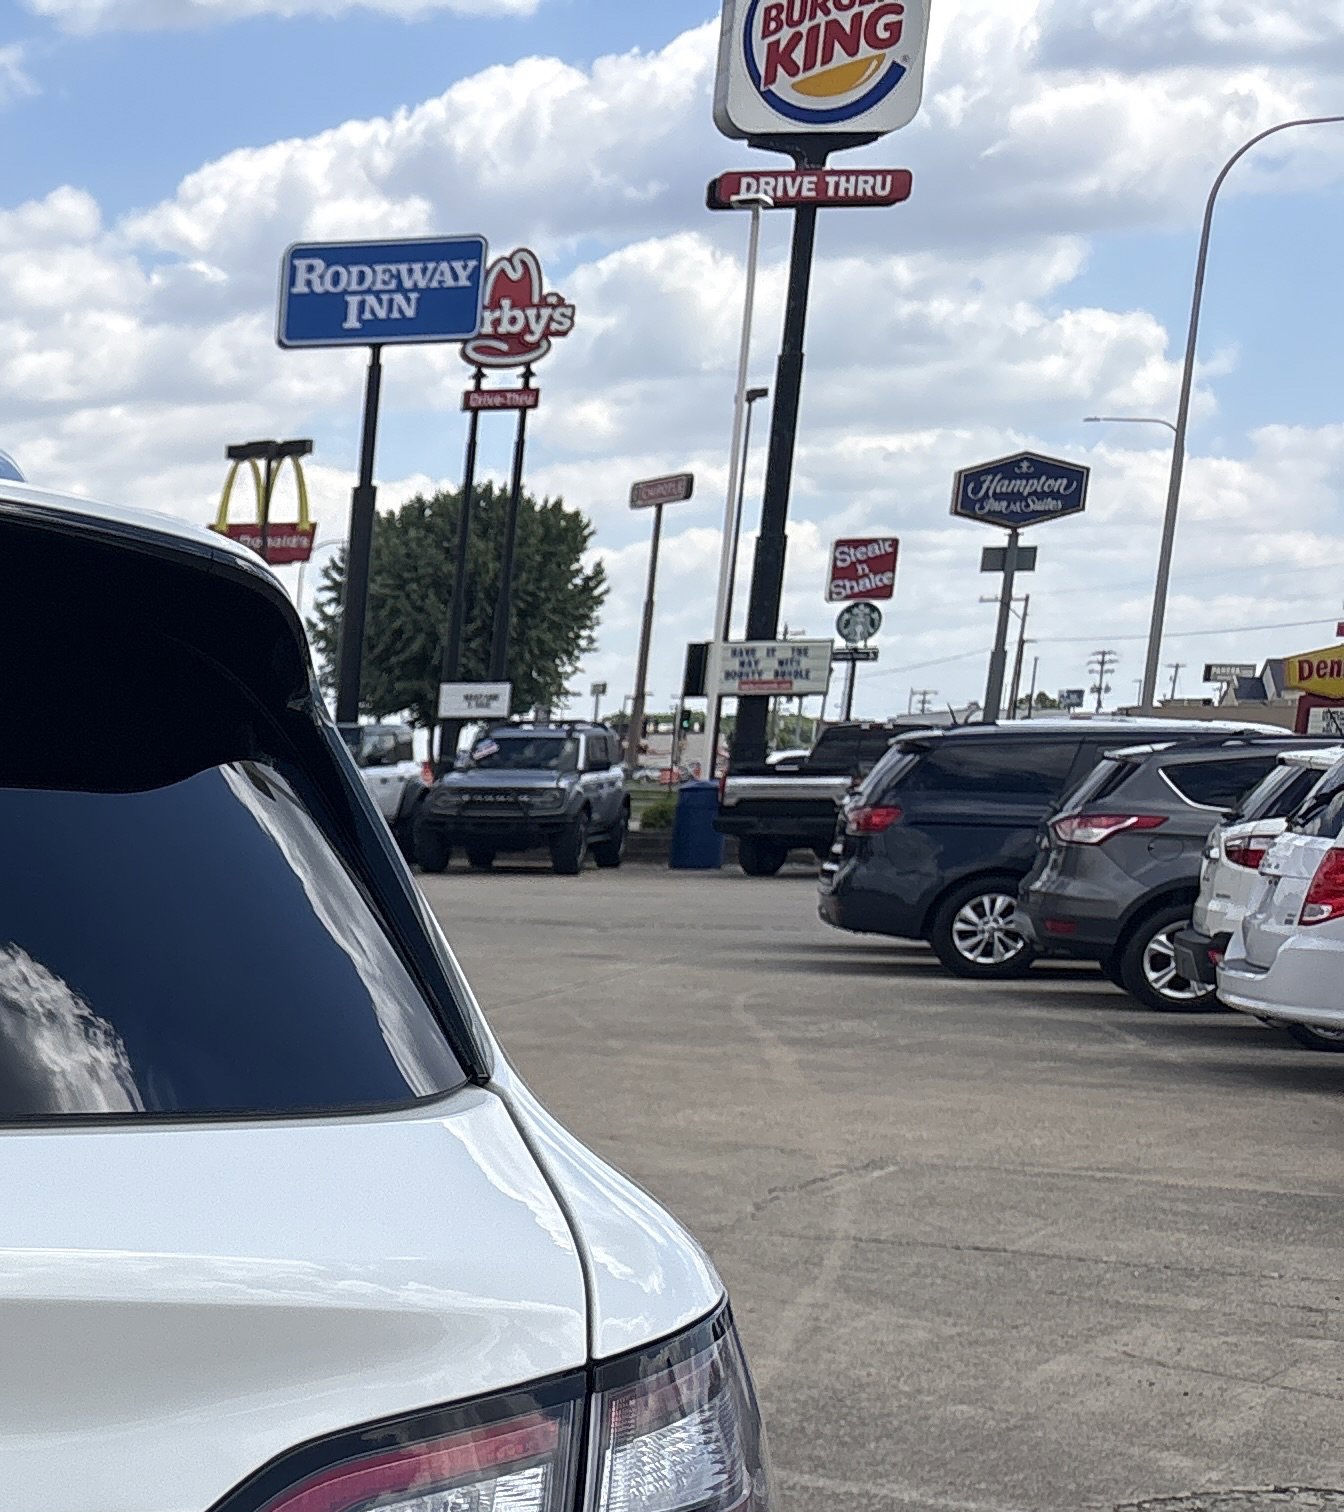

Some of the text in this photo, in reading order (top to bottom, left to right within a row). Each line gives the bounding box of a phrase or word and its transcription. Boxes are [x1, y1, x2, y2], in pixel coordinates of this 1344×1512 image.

[761, 0, 883, 40] BUR
[764, 3, 905, 87] KING
[739, 175, 892, 197] DRIVE THRU
[290, 257, 478, 294] RODEWAY
[342, 291, 420, 329] INN
[479, 294, 573, 343] rby's
[967, 472, 1077, 500] Hampton
[835, 539, 895, 568] Steak
[856, 562, 869, 577] n
[831, 571, 894, 600] Shake
[1298, 659, 1344, 681] Den
